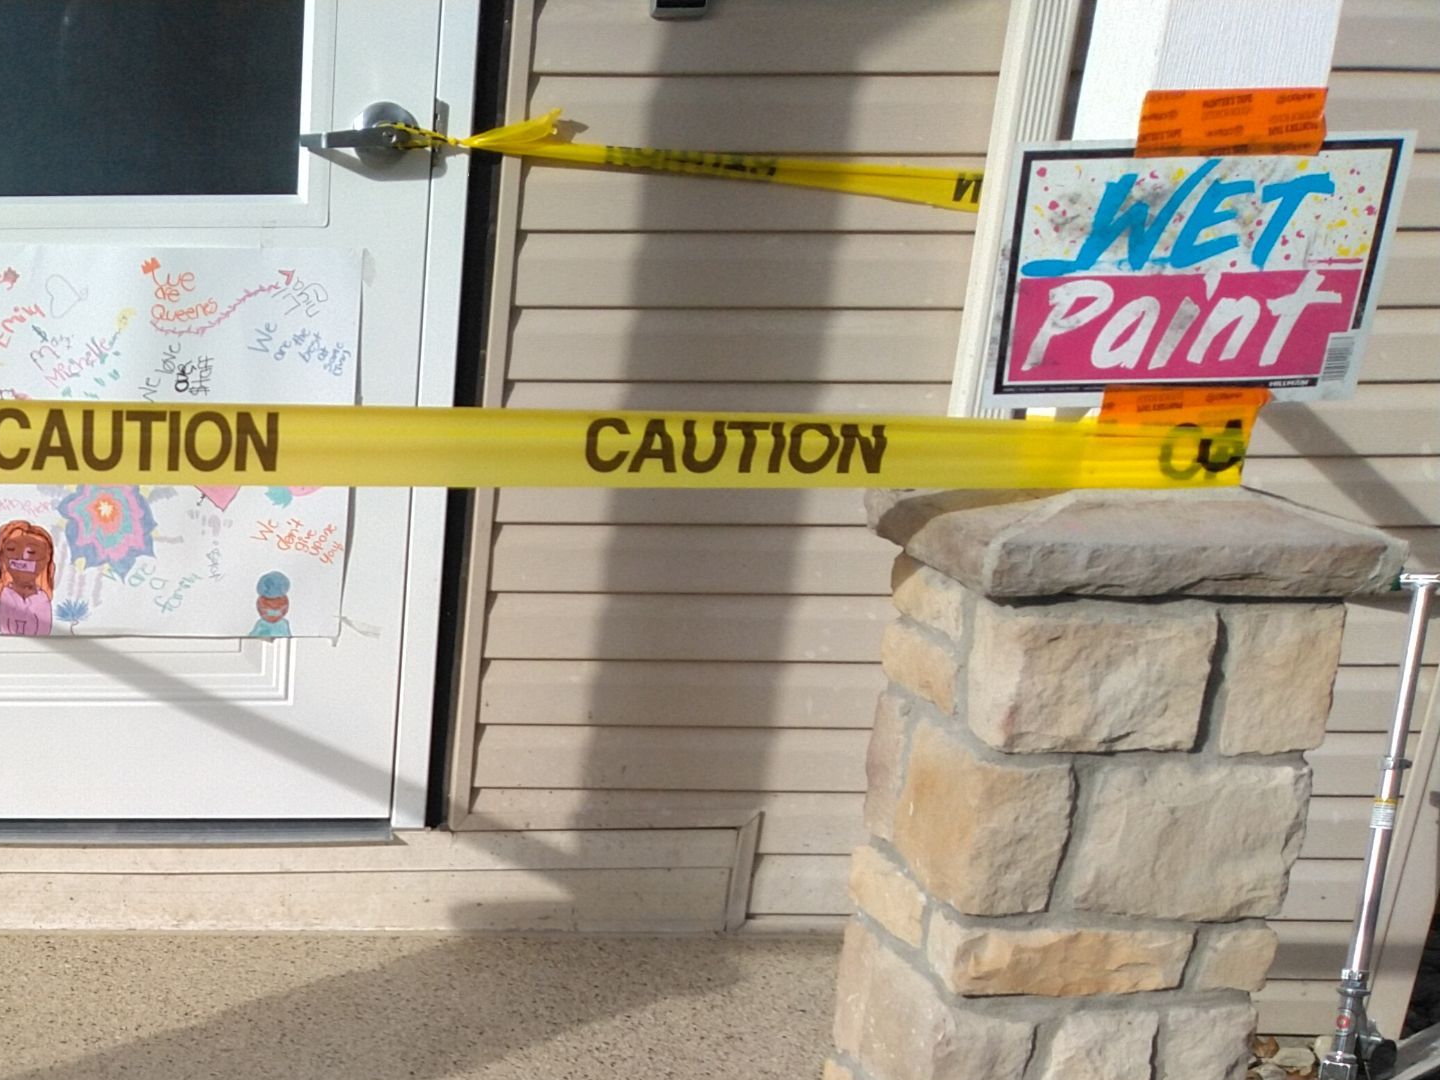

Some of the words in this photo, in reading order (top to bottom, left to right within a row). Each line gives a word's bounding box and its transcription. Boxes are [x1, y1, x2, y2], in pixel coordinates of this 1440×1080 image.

[1021, 159, 1335, 277] WET
[247, 322, 278, 354] We
[1021, 270, 1342, 371] Paint
[584, 417, 888, 474] CAUTION
[250, 519, 280, 541] We
